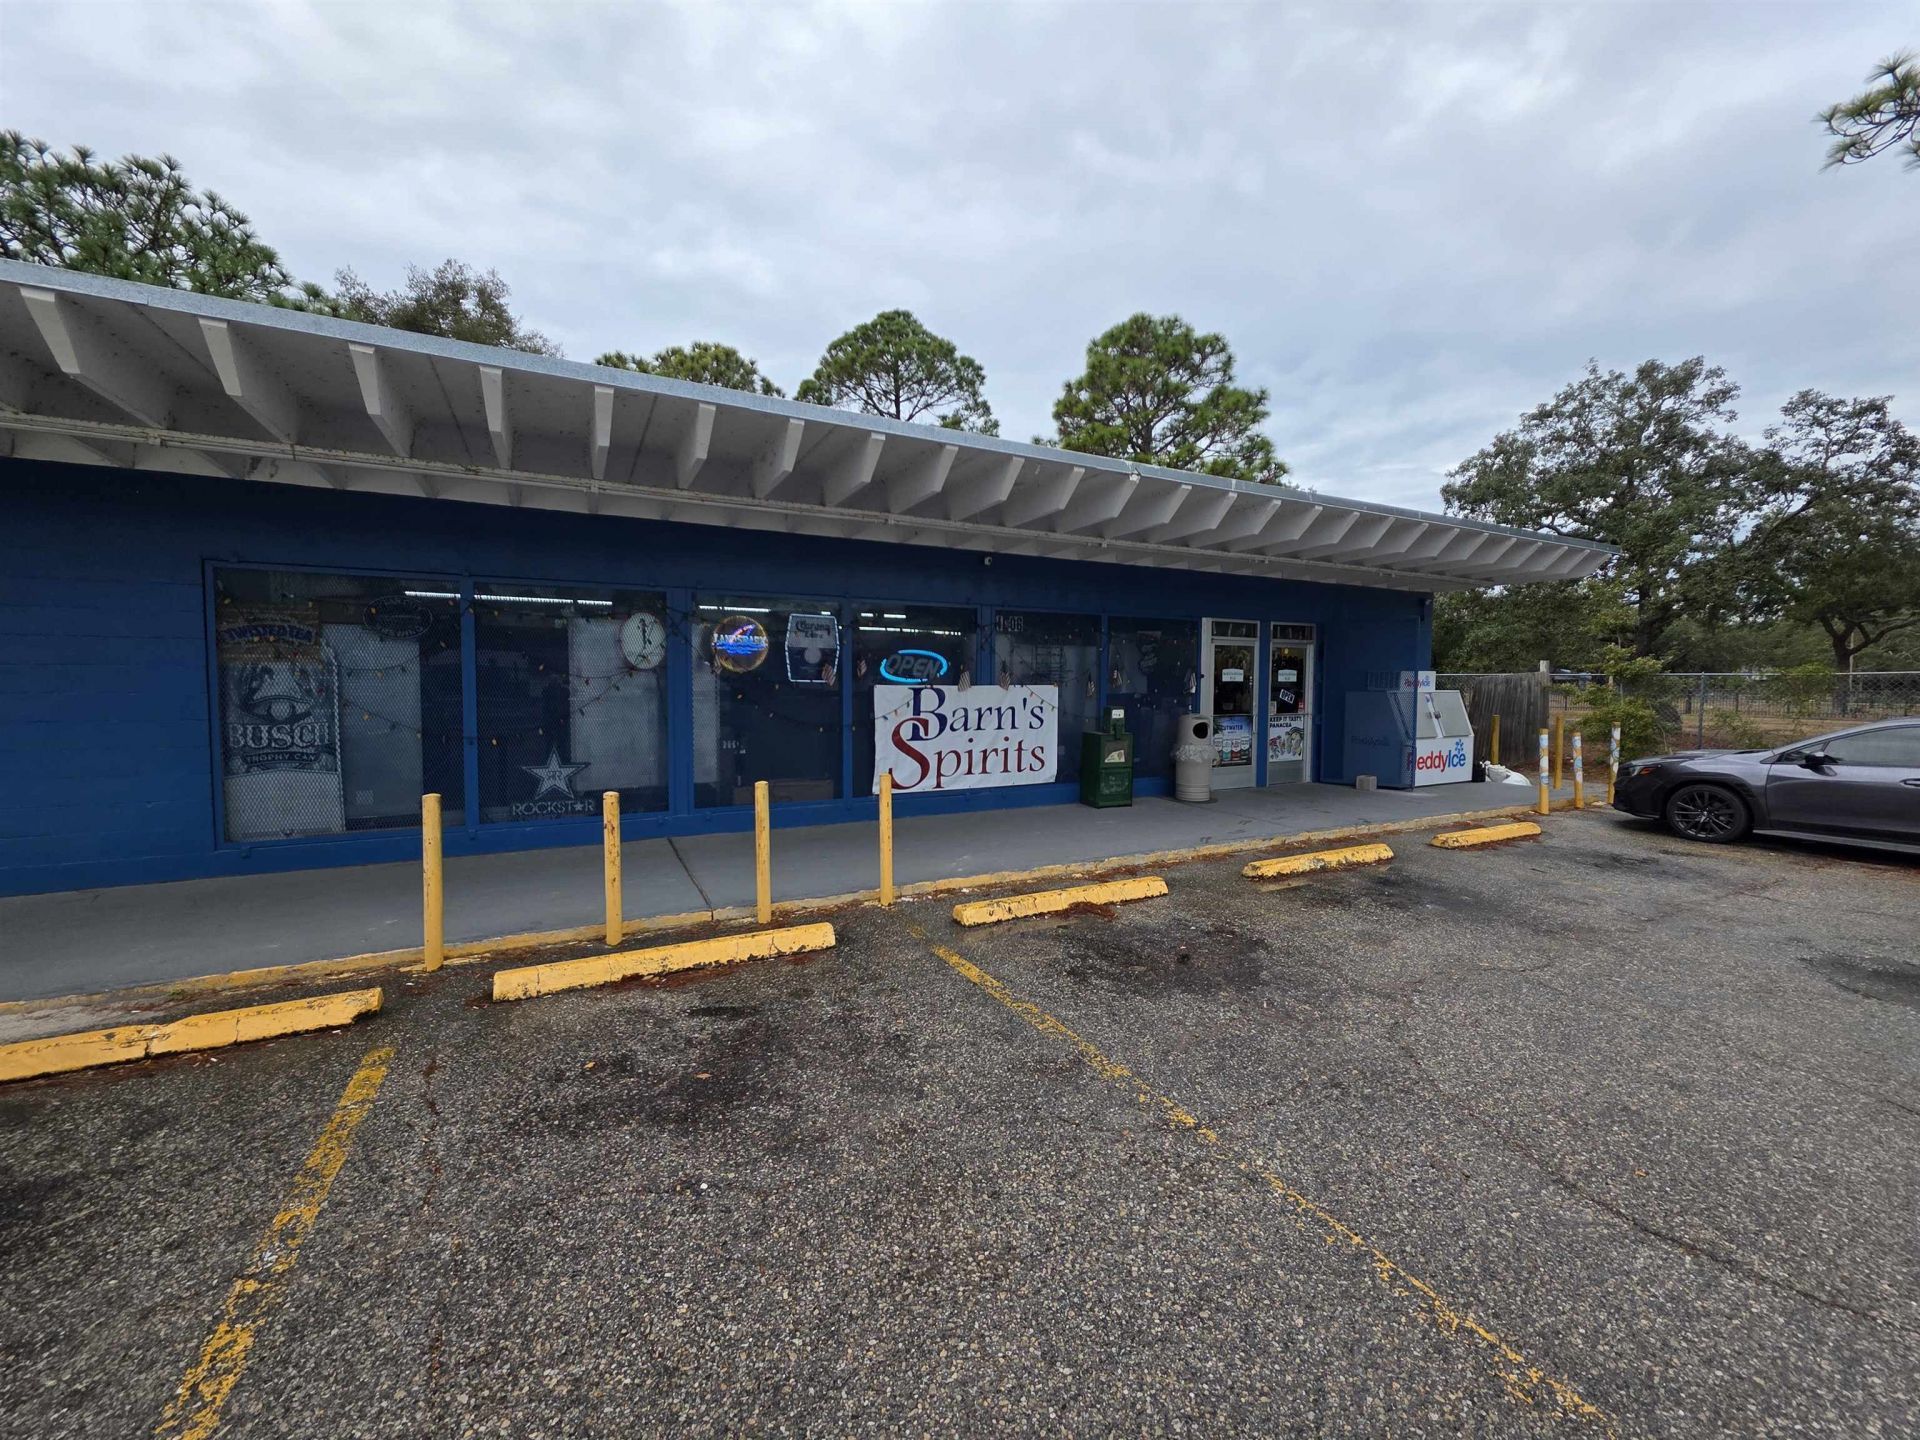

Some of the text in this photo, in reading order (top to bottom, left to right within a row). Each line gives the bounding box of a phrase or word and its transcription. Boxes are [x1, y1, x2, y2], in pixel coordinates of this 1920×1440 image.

[886, 654, 940, 677] OPEN
[1281, 690, 1294, 702] OPEN
[906, 687, 1045, 741] Barn's
[228, 723, 330, 748] BUSCH
[889, 717, 1046, 790] Spirits
